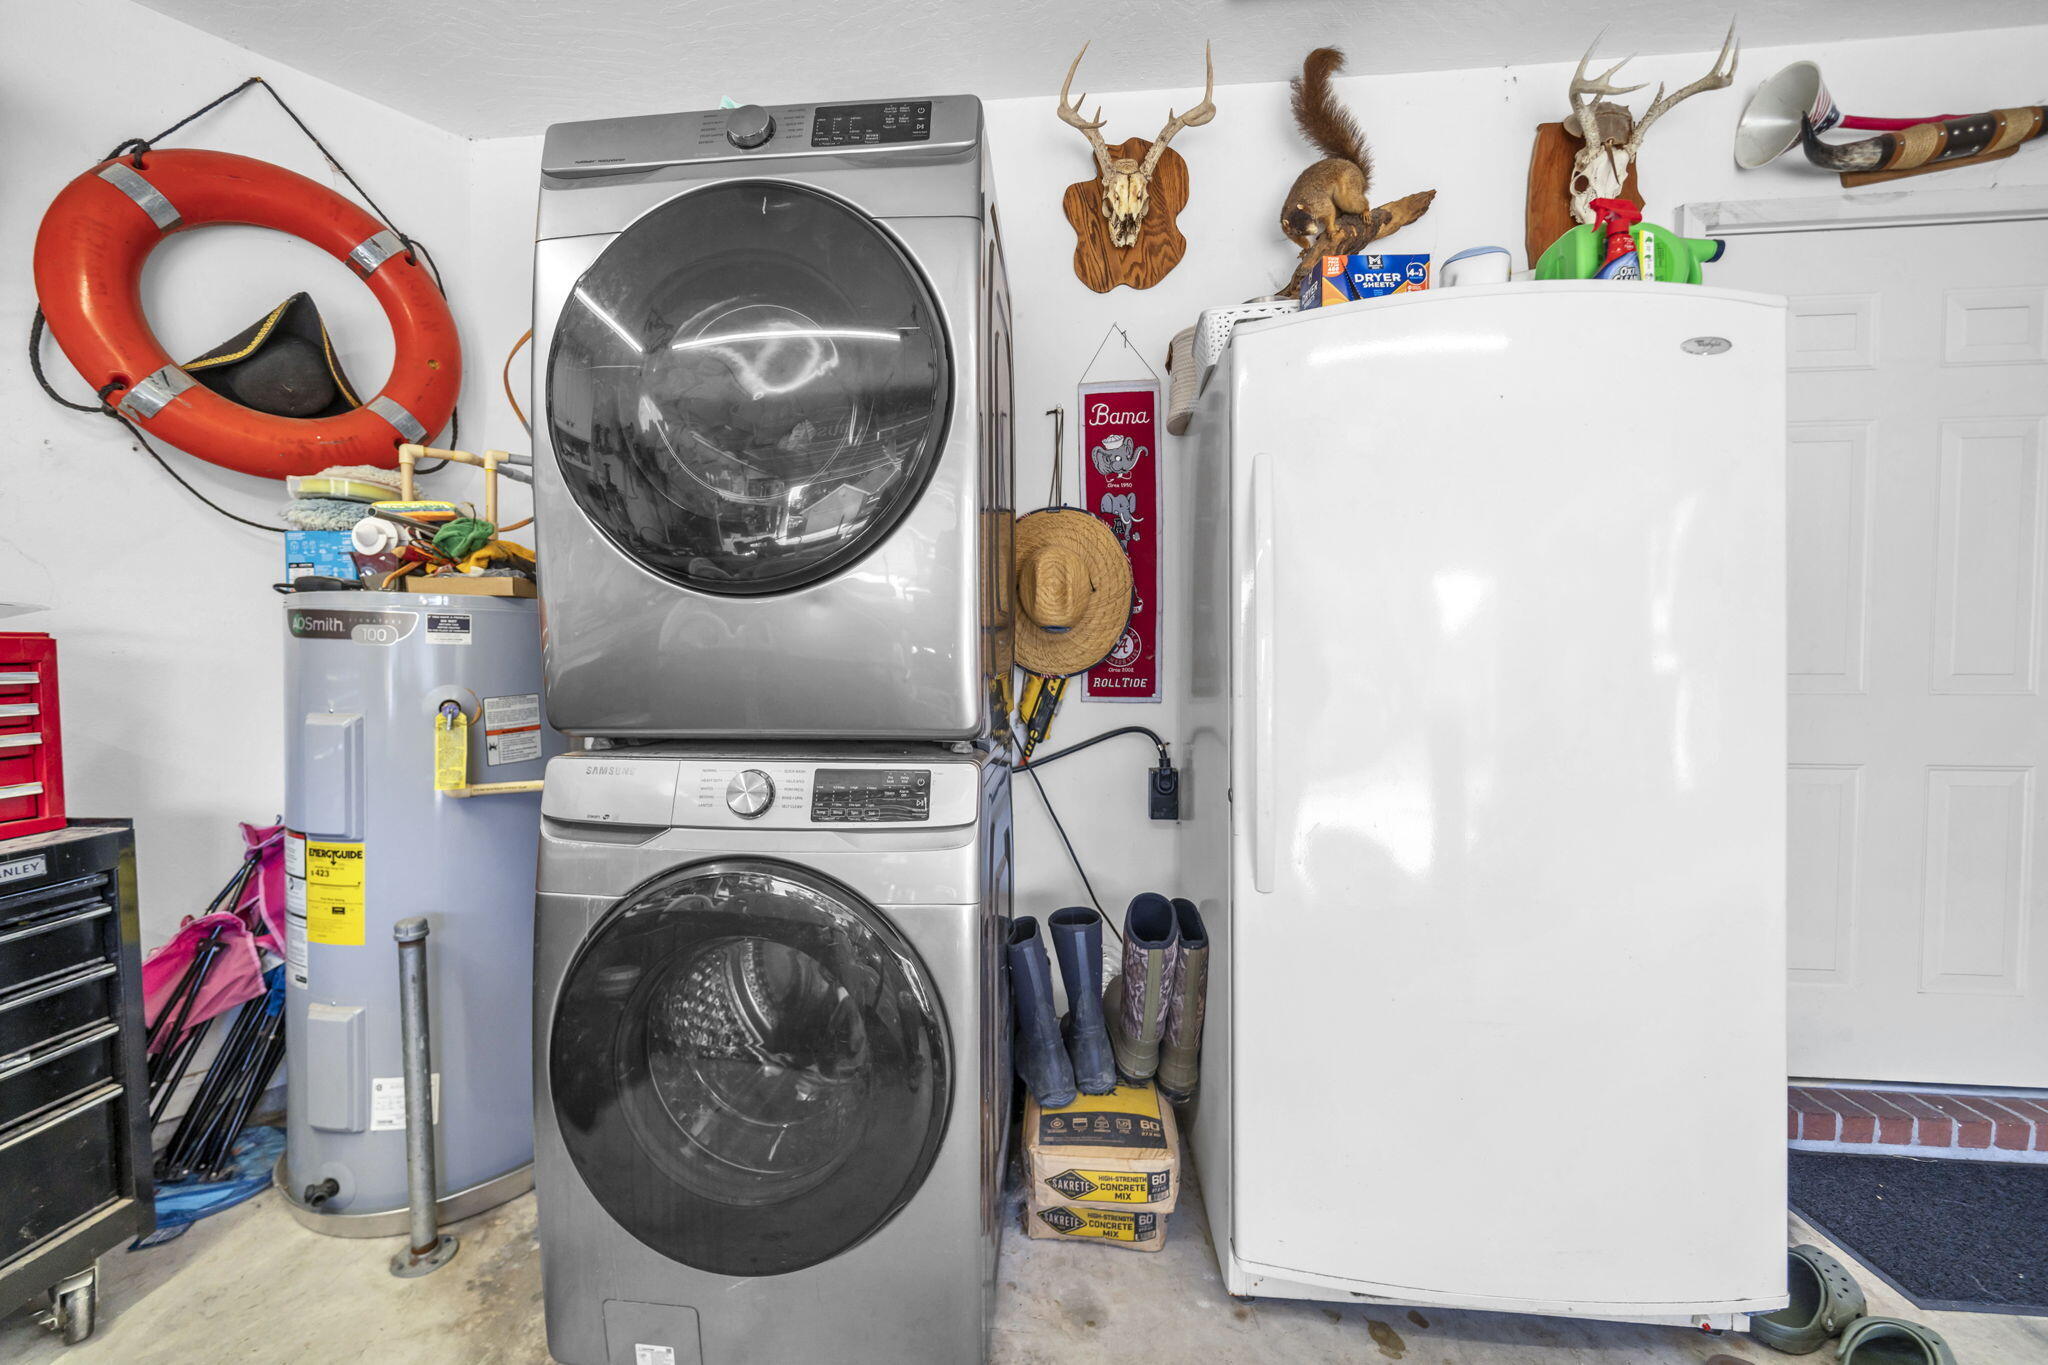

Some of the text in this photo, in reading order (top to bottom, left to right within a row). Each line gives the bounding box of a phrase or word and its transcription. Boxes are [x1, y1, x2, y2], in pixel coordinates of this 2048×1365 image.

[1620, 266, 1637, 275] OXI
[1354, 273, 1402, 283] DRYER
[1089, 403, 1151, 426] Bama
[361, 628, 388, 642] 100
[1093, 677, 1148, 688] ROLL TIDE
[0, 862, 40, 878] NLEY
[1139, 1119, 1160, 1131] 60
[1052, 1178, 1091, 1192] SAKRETE
[1151, 1173, 1167, 1186] 60
[1100, 1183, 1147, 1192] CONCRETE
[1044, 1211, 1081, 1227] SAKRETE
[1088, 1219, 1134, 1230] CONCRETE
[1138, 1214, 1154, 1225] 60
